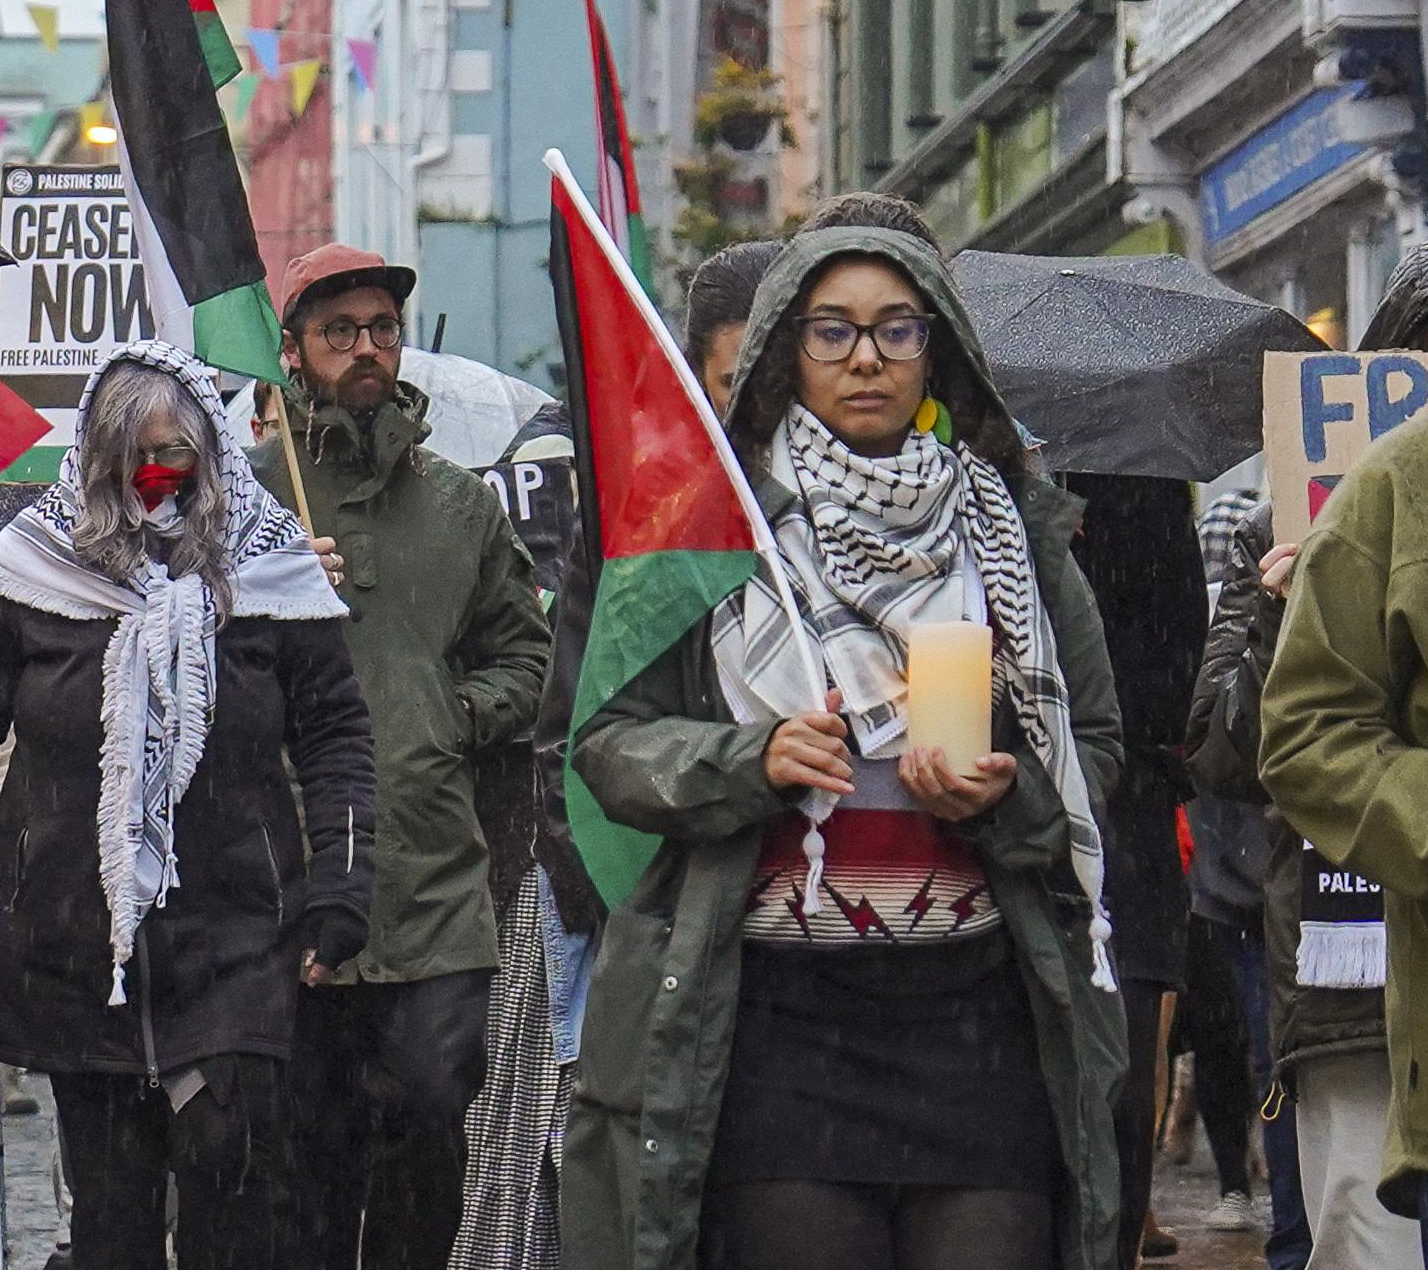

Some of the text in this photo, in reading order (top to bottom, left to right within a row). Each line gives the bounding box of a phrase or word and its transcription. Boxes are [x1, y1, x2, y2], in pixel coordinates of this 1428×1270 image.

[38, 173, 93, 190] PALESTINE
[28, 263, 158, 343] NOW
[1, 349, 29, 366] FREE
